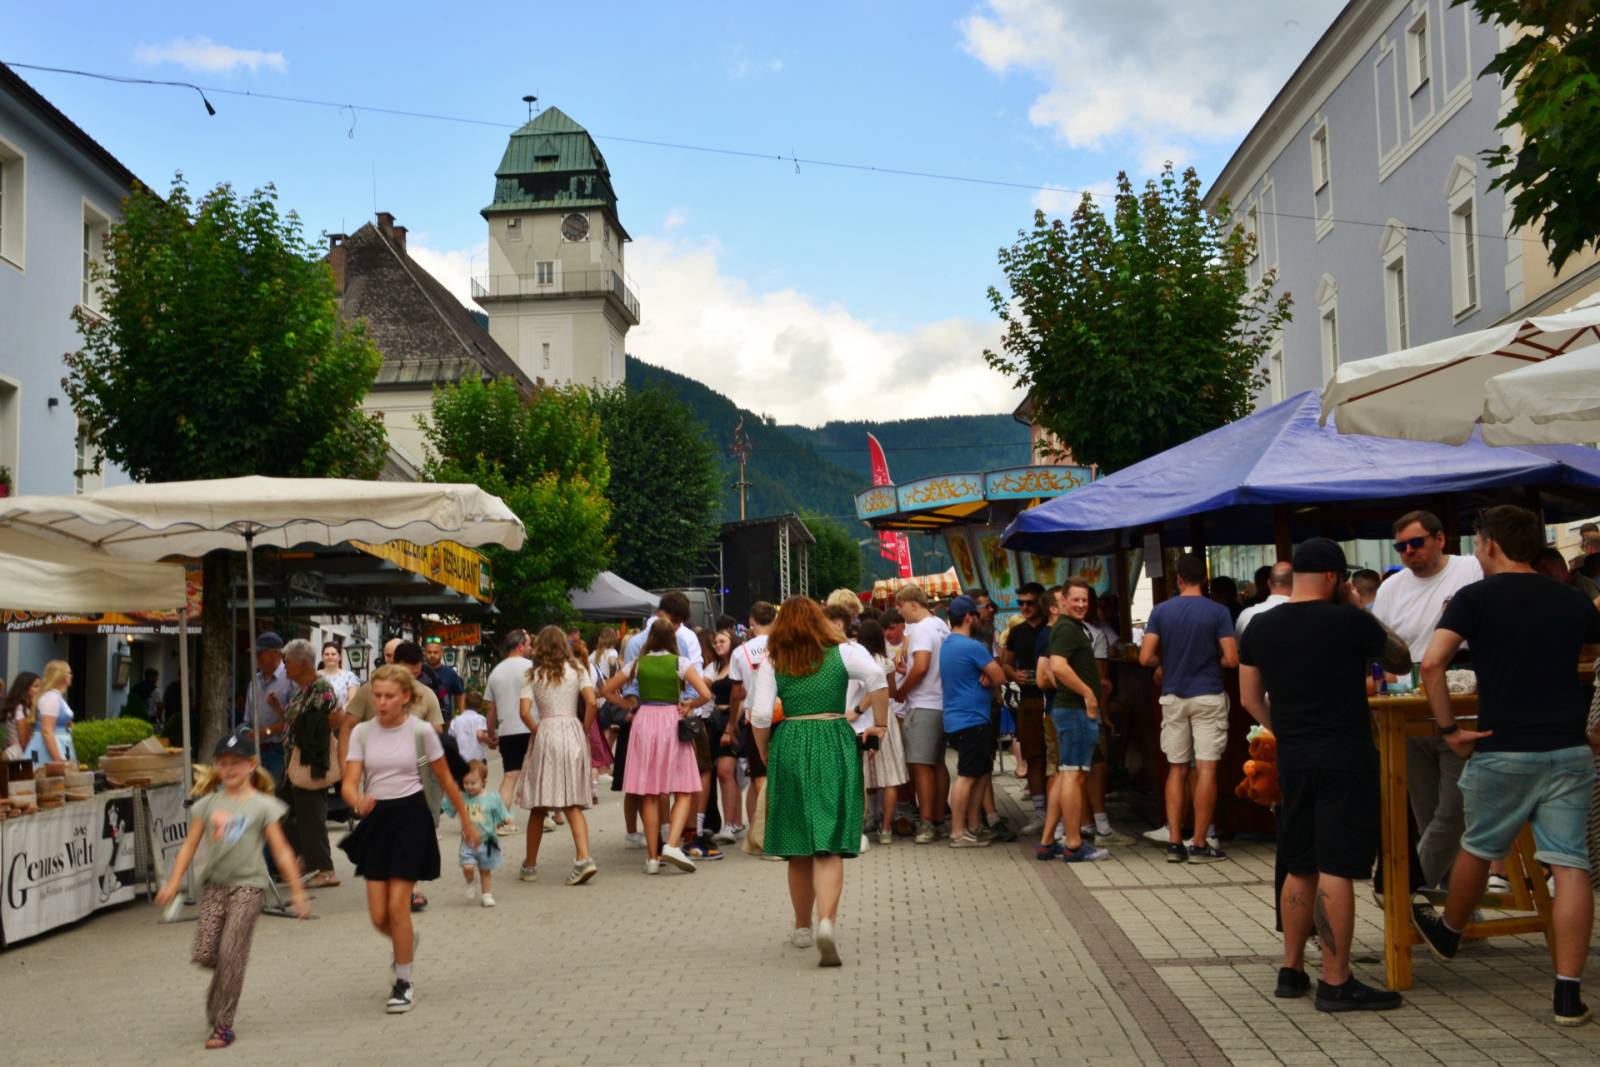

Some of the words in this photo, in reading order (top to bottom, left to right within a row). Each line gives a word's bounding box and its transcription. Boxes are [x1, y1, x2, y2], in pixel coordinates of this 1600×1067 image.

[7, 618, 43, 631] Pizzeria
[8, 851, 65, 910] Genuss
[65, 838, 94, 869] Welt
